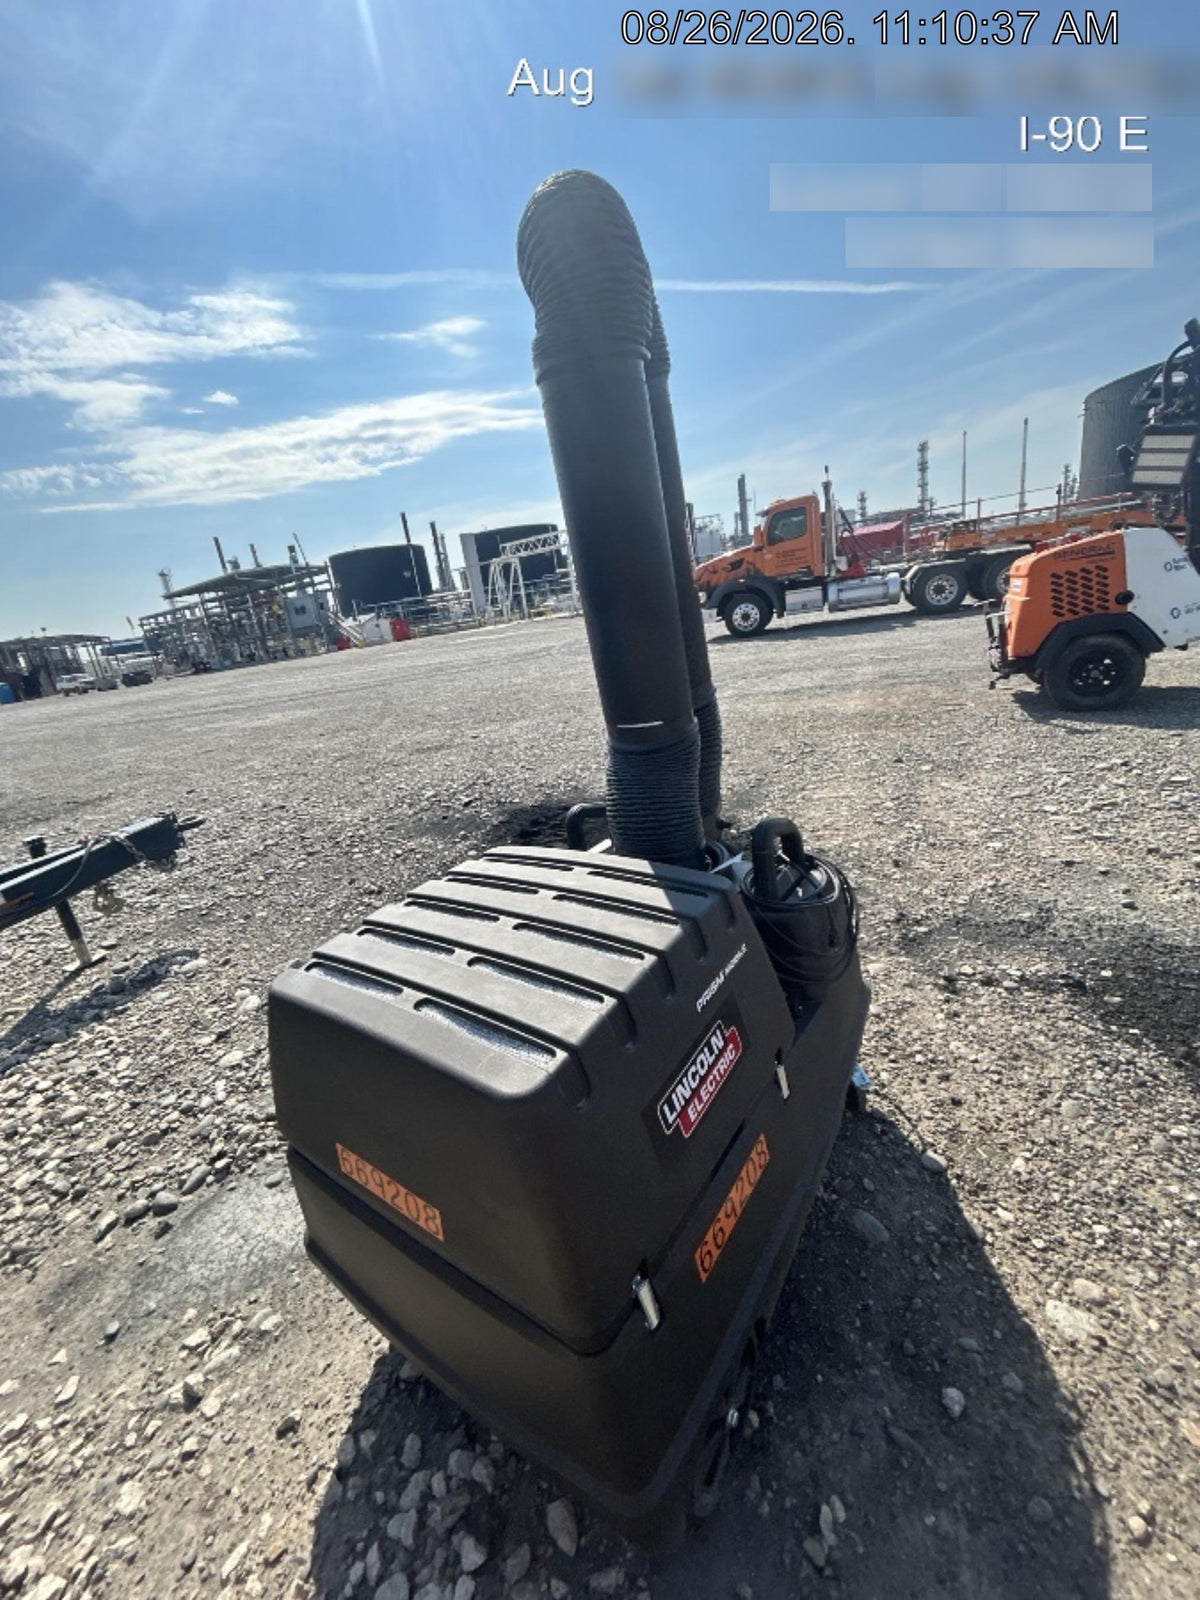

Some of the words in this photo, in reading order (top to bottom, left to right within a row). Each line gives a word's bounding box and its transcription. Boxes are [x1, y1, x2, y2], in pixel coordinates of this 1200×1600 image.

[662, 1029, 725, 1125] LINCOLN
[687, 1043, 736, 1123] ELECTRIC
[340, 1147, 440, 1237] 669208
[699, 1139, 768, 1275] 669208
